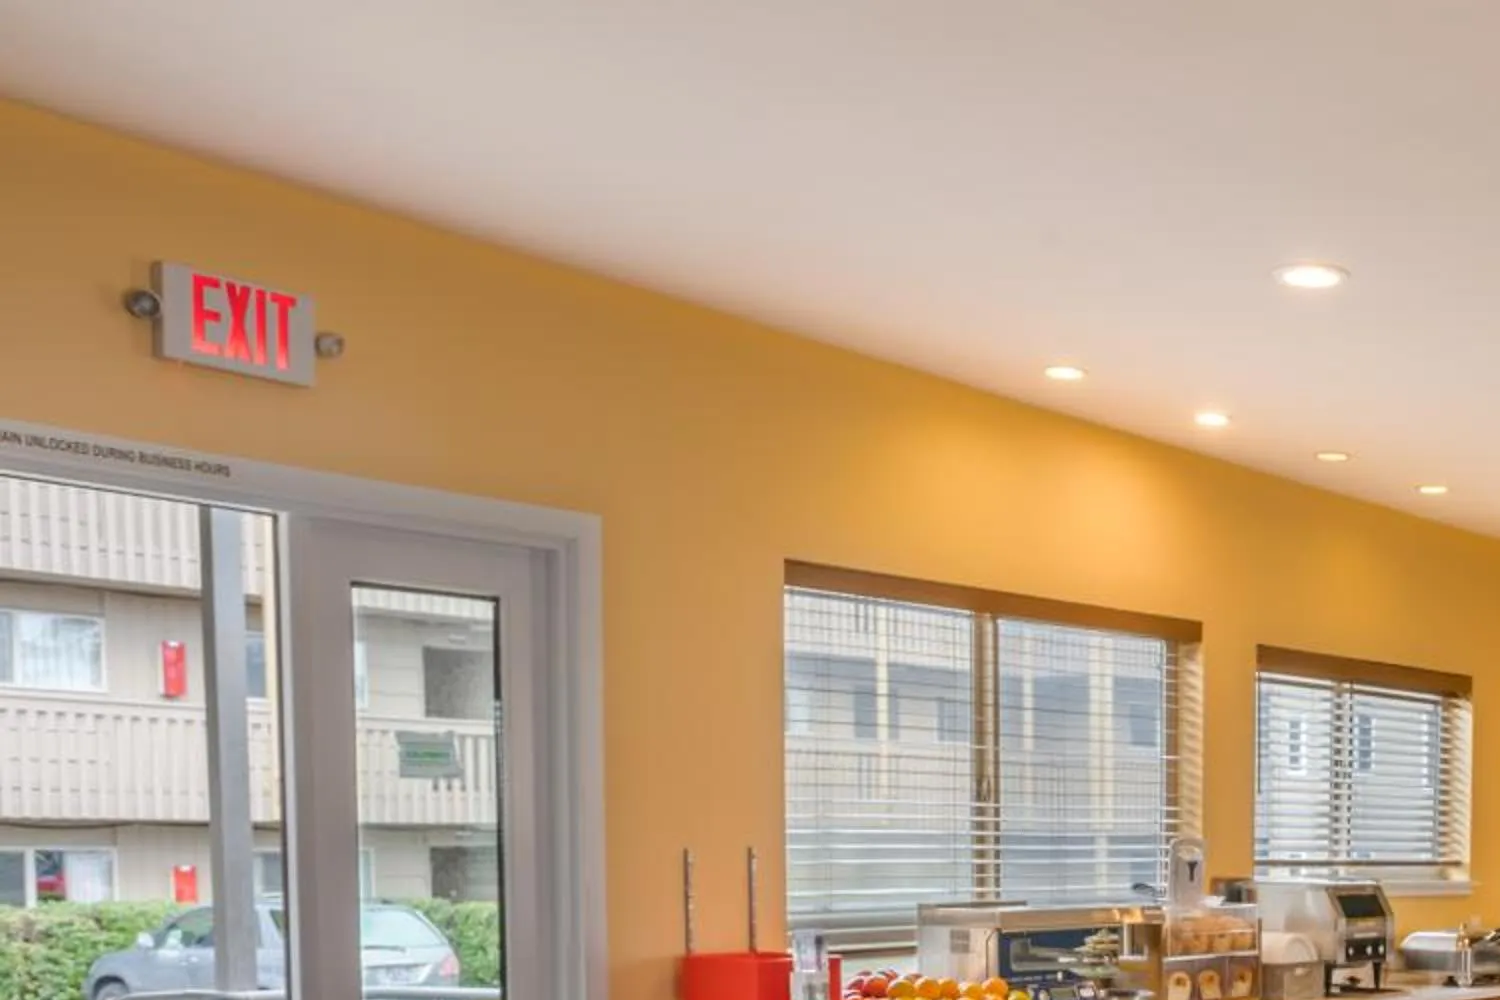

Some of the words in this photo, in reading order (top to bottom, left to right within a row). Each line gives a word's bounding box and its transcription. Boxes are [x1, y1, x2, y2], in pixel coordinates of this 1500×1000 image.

[192, 274, 297, 371] EXIT
[0, 431, 22, 445] AIN
[25, 434, 89, 455] UNLOCKED
[92, 444, 135, 463] DURING
[139, 451, 192, 471] BUSINESS
[194, 461, 231, 478] HOURS
